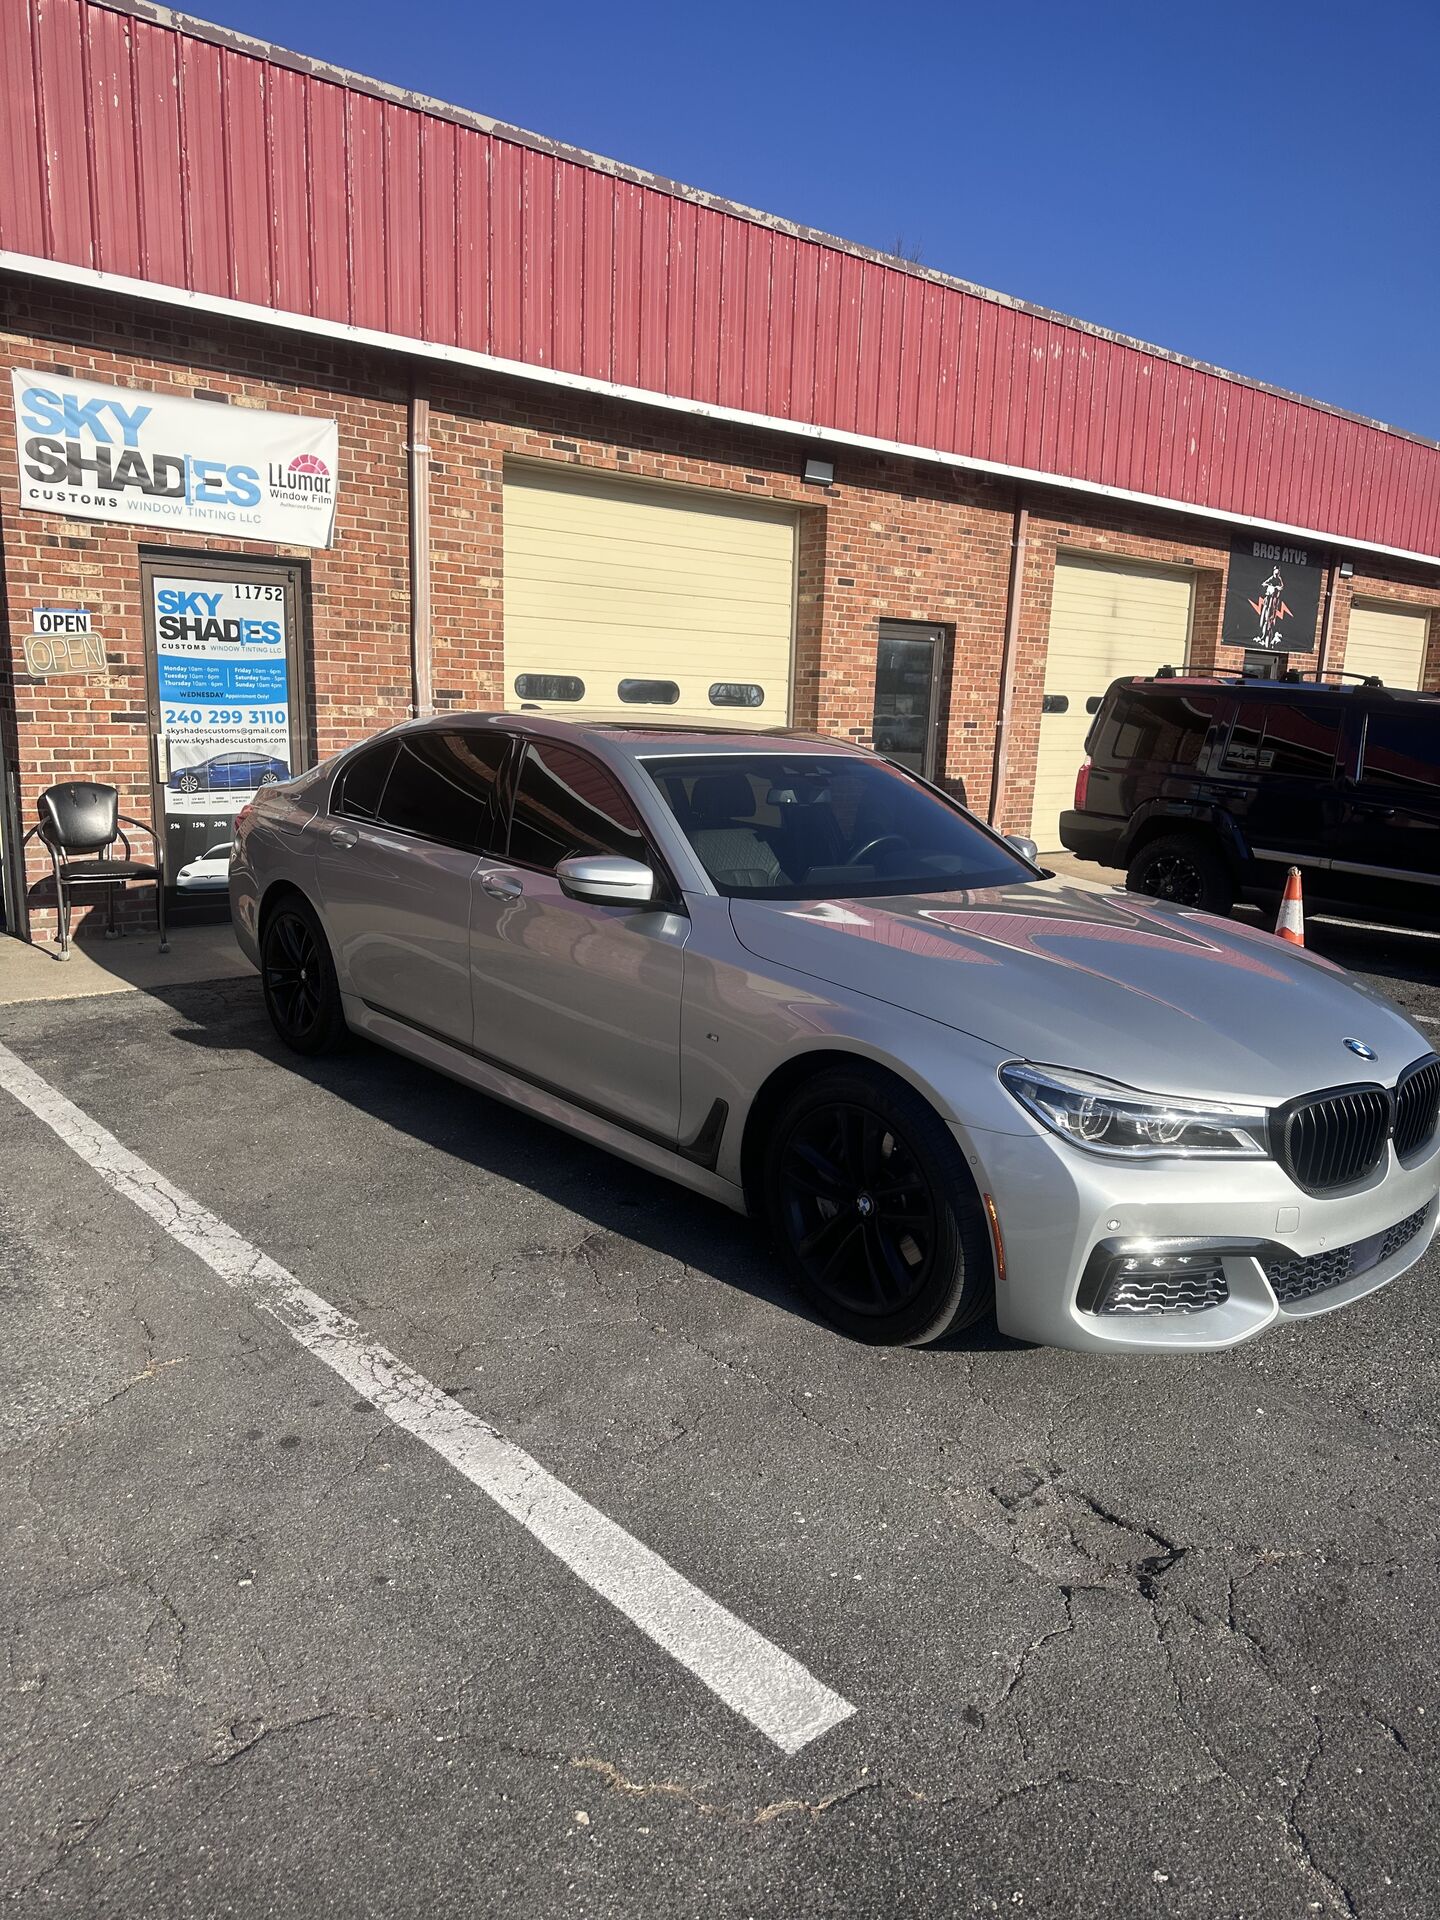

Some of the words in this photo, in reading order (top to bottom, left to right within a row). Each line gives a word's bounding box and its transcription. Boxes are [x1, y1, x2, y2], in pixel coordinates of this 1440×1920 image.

[21, 387, 153, 447] SKY
[24, 437, 262, 508] SHADES
[269, 463, 331, 493] LLumar
[29, 488, 118, 507] CUSTOMS
[127, 499, 183, 515] WINDOW
[187, 504, 236, 521] TINTING
[239, 512, 262, 525] LLC
[269, 489, 309, 501] Window
[312, 494, 332, 504] Film
[1253, 542, 1280, 560] BROS
[1282, 547, 1308, 565] ATVS
[158, 589, 224, 616] SKY
[234, 585, 283, 602] 11752
[40, 614, 87, 632] OPEN
[159, 616, 282, 646] SHADES
[30, 637, 102, 670] OPEN
[164, 666, 187, 674] Monday
[165, 710, 202, 724] 240
[208, 710, 243, 724] 299
[248, 710, 286, 724] 3110
[166, 727, 287, 735] skyshadescustoms@gmail.com
[170, 737, 286, 745] www.skyshadescustoms.com
